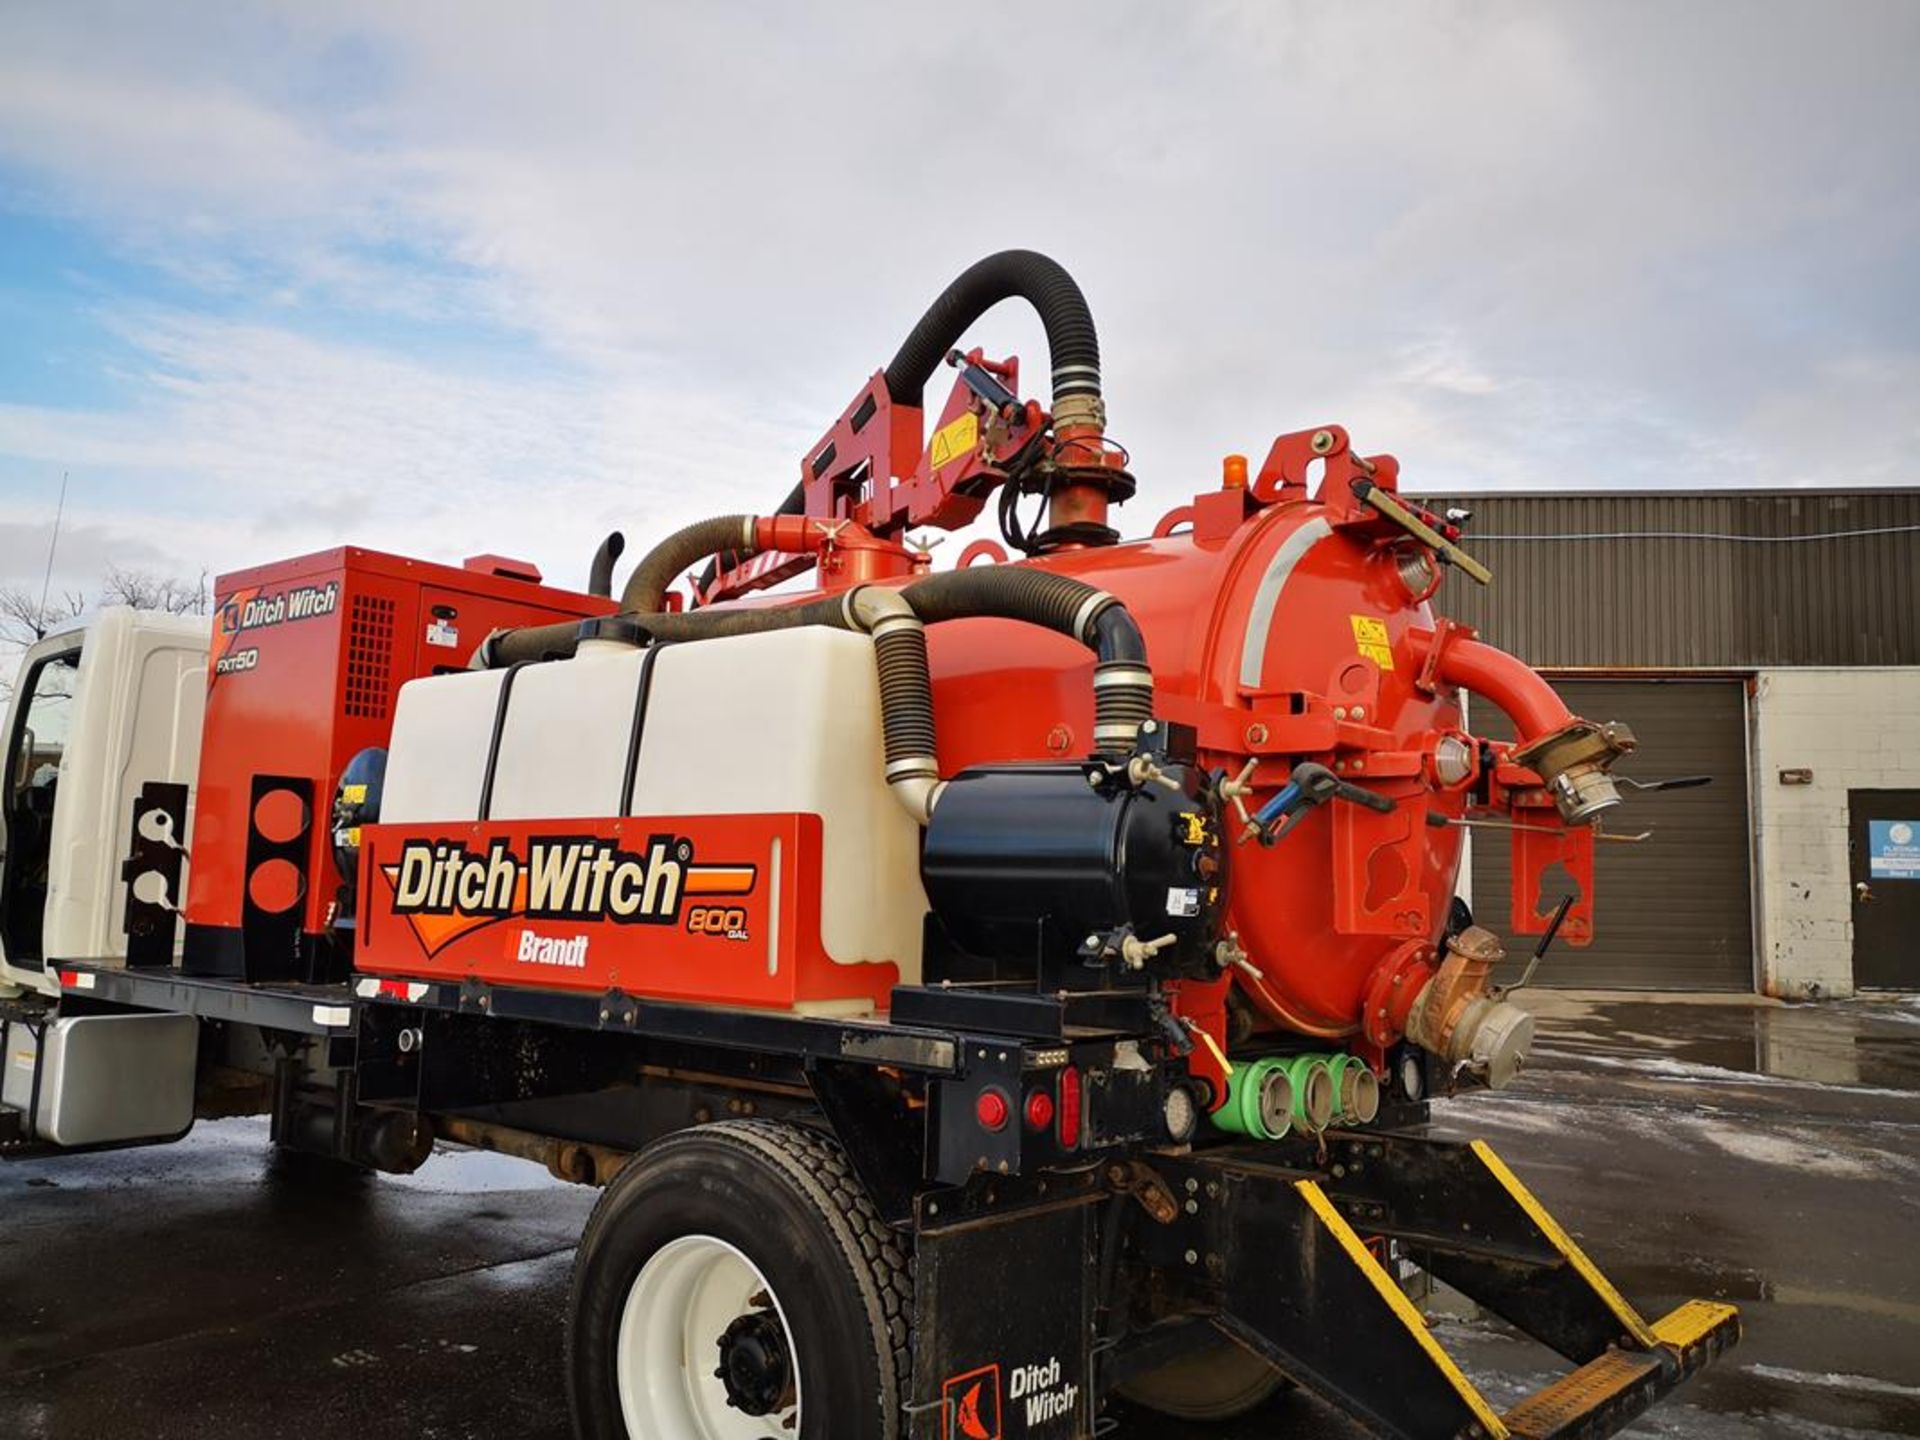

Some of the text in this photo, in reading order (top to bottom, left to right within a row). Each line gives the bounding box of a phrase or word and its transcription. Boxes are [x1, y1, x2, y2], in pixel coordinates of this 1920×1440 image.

[242, 584, 335, 628] Ditch Witch
[216, 649, 258, 673] FXT50
[396, 845, 515, 908] Ditch
[688, 908, 745, 932] 800
[727, 930, 749, 940] GAL
[517, 929, 589, 968] Brandt
[1010, 1356, 1061, 1399] Ditch
[1026, 1382, 1076, 1427] Witch
